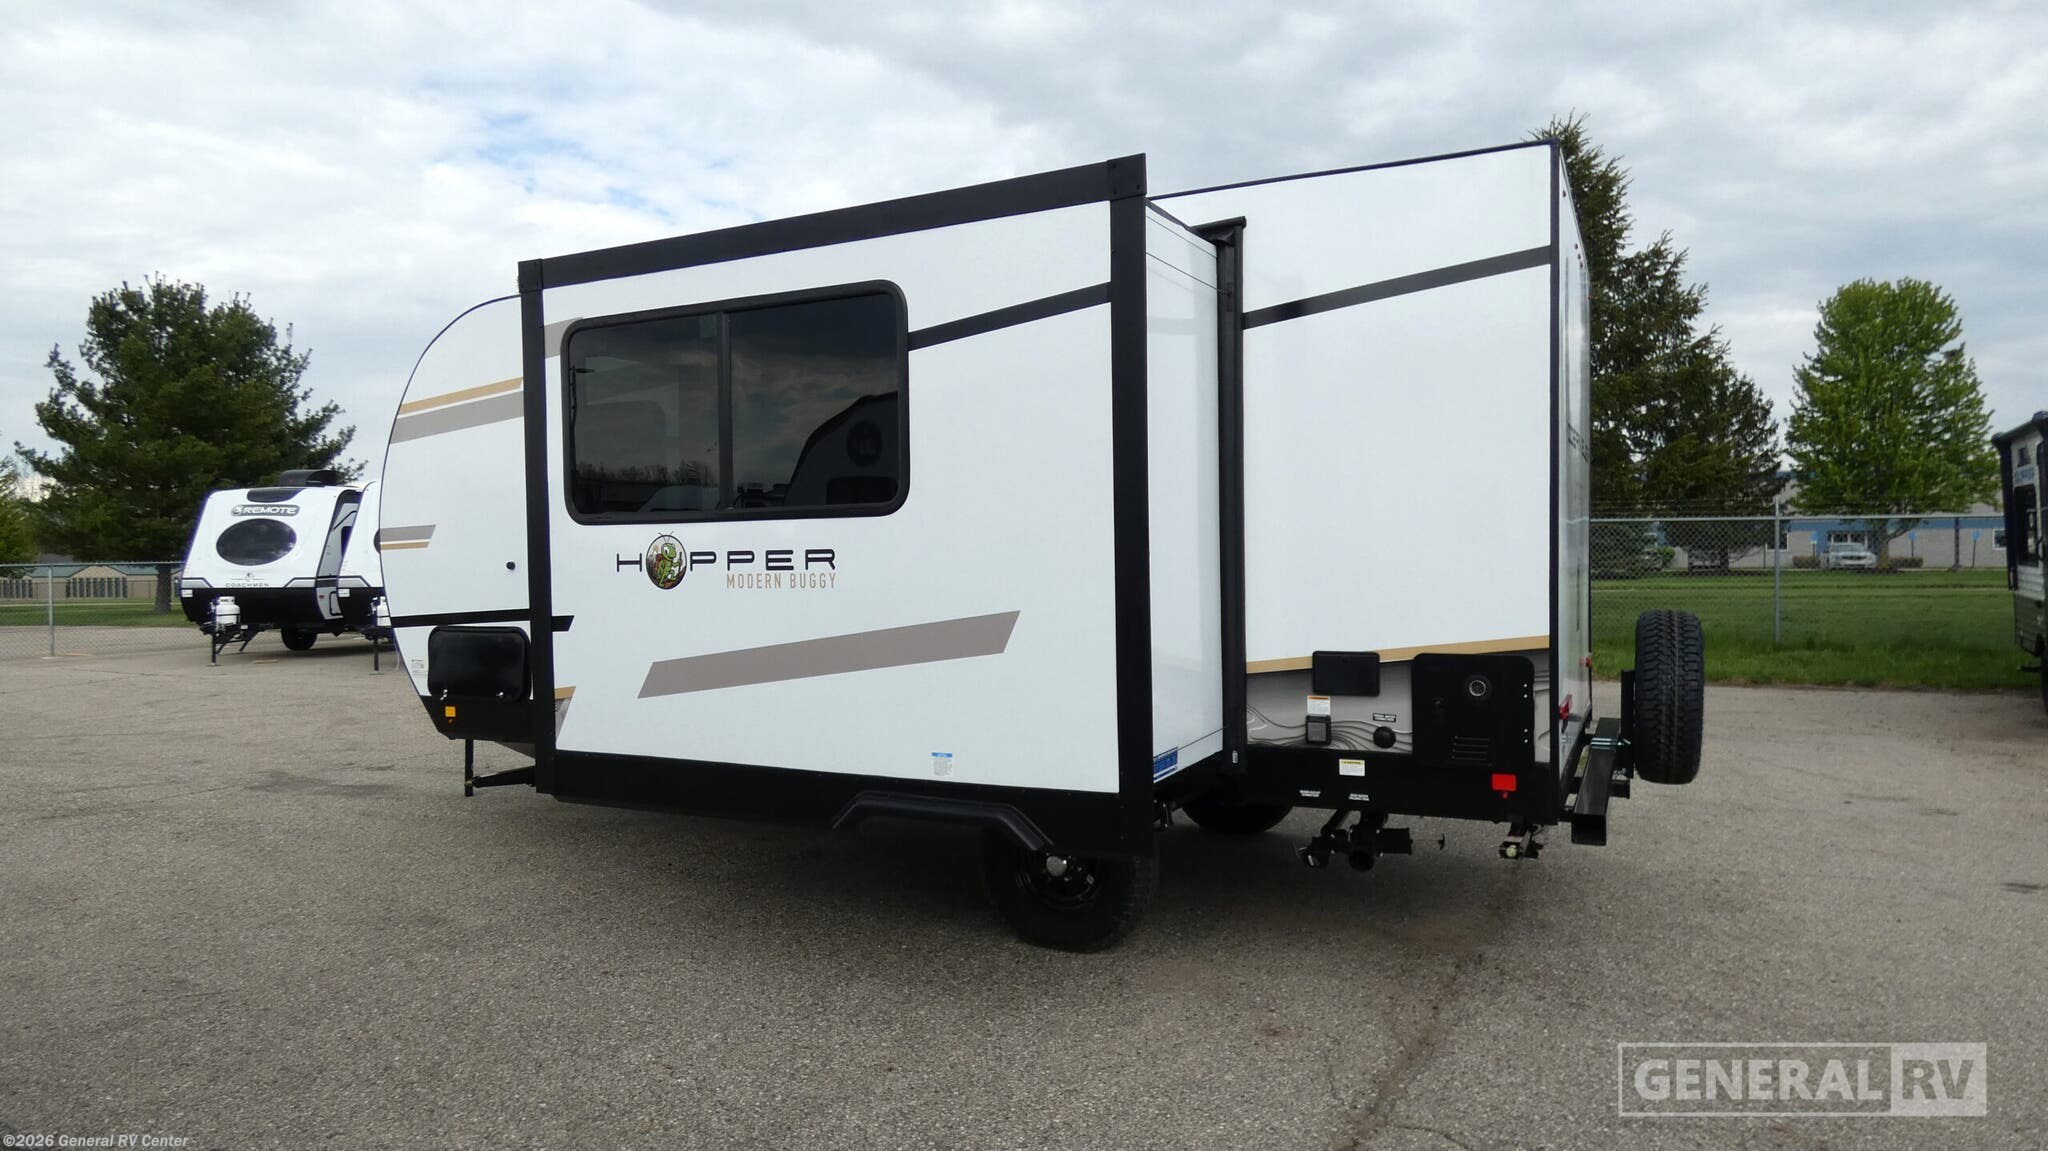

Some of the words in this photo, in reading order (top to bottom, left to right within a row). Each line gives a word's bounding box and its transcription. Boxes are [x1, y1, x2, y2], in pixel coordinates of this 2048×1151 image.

[243, 505, 298, 515] REMOTE
[616, 534, 836, 590] HOPPER
[726, 573, 782, 589] MODERN
[790, 572, 837, 589] BUGGY
